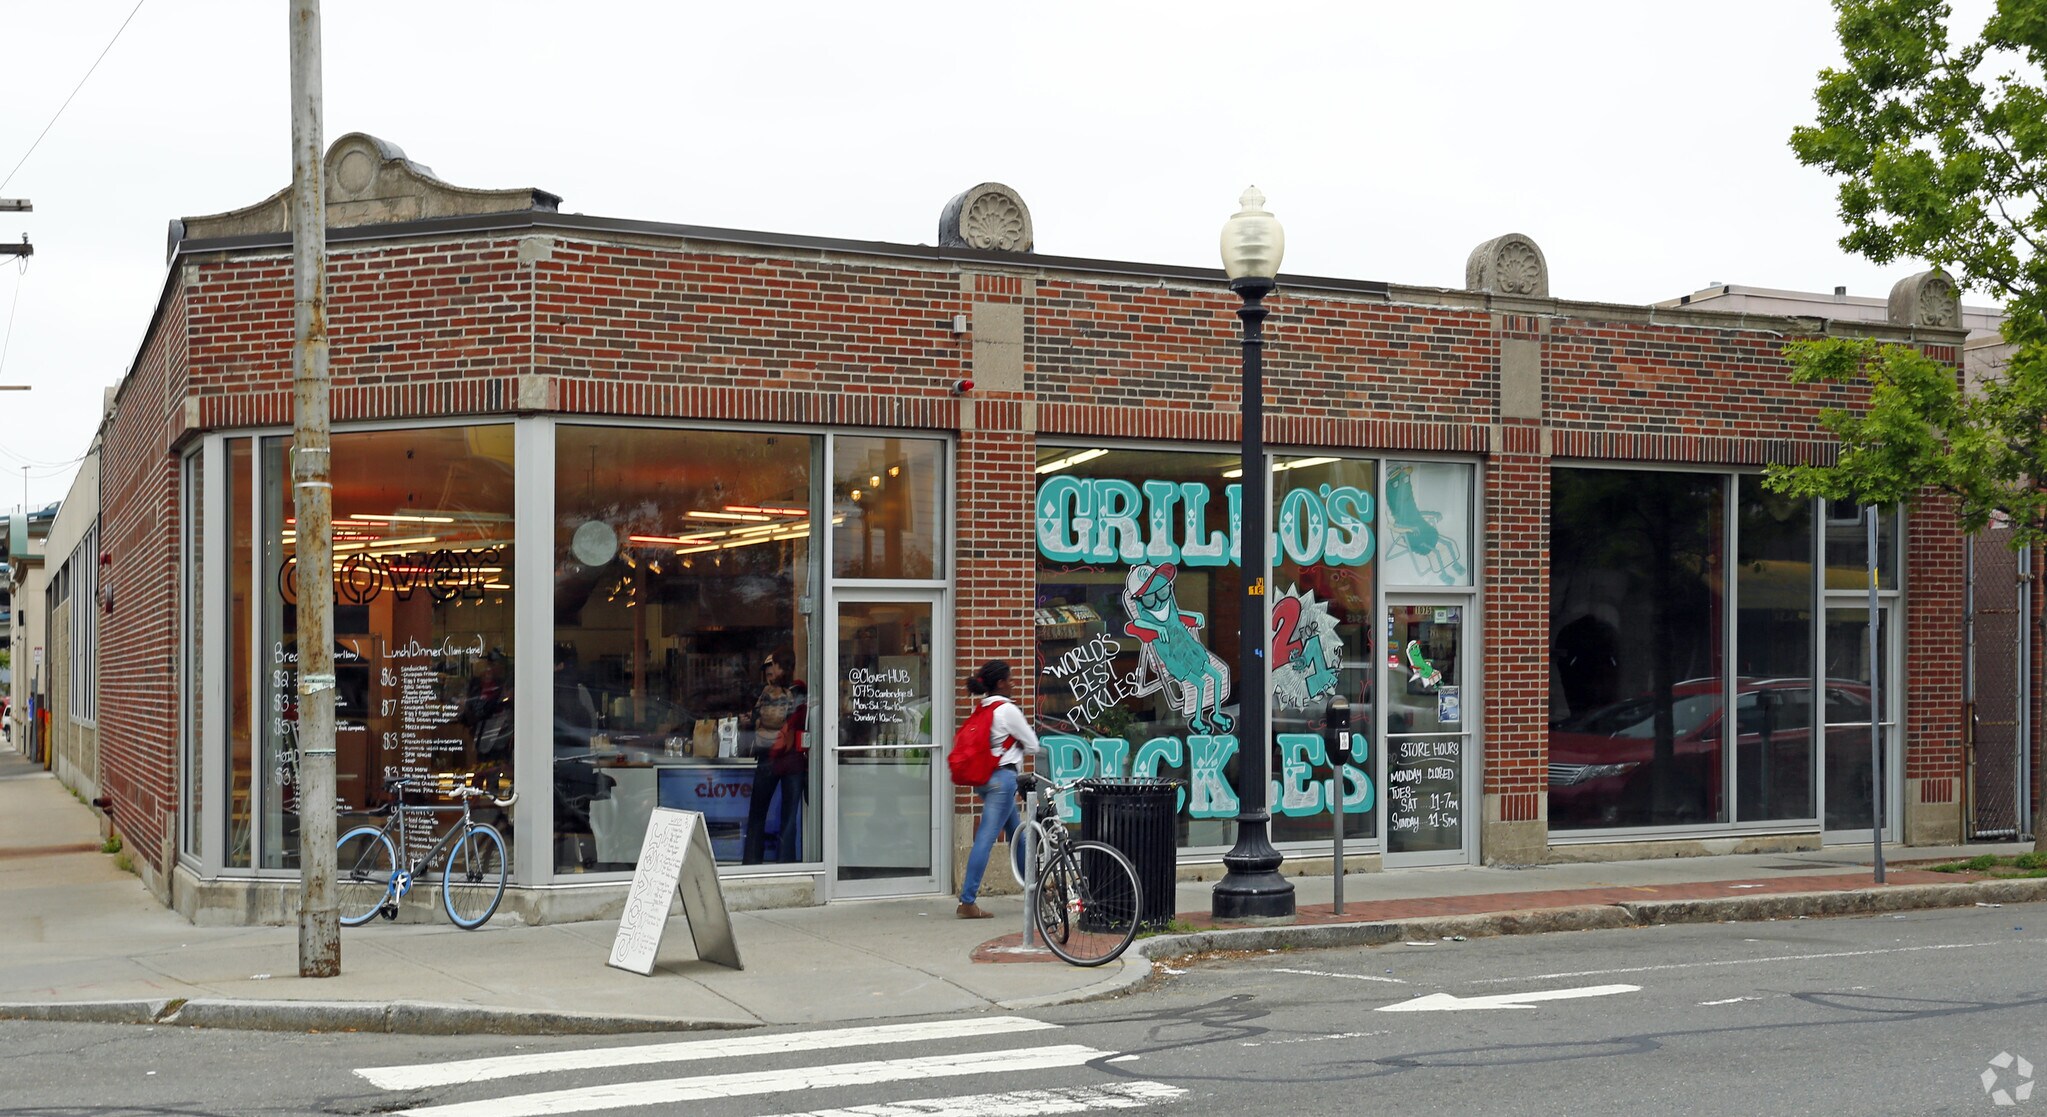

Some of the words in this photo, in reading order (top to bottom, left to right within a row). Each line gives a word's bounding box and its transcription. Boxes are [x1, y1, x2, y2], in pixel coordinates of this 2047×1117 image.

[1299, 621, 1319, 638] FOR
[273, 669, 289, 688] $2
[380, 667, 397, 687] $6
[1069, 656, 1117, 701] BEST
[852, 684, 875, 698] 1075
[273, 693, 289, 712] $3
[381, 699, 397, 717] $7
[273, 717, 290, 736] $5
[382, 731, 398, 750] $3
[1400, 741, 1431, 758] STORE
[1432, 741, 1460, 757] HOURS
[274, 766, 291, 786] $3
[1040, 734, 1375, 824] PICKES
[1390, 767, 1423, 785] MONDAY
[1427, 765, 1454, 781] CLOSED
[694, 776, 753, 798] clove
[1400, 797, 1419, 813] SAT
